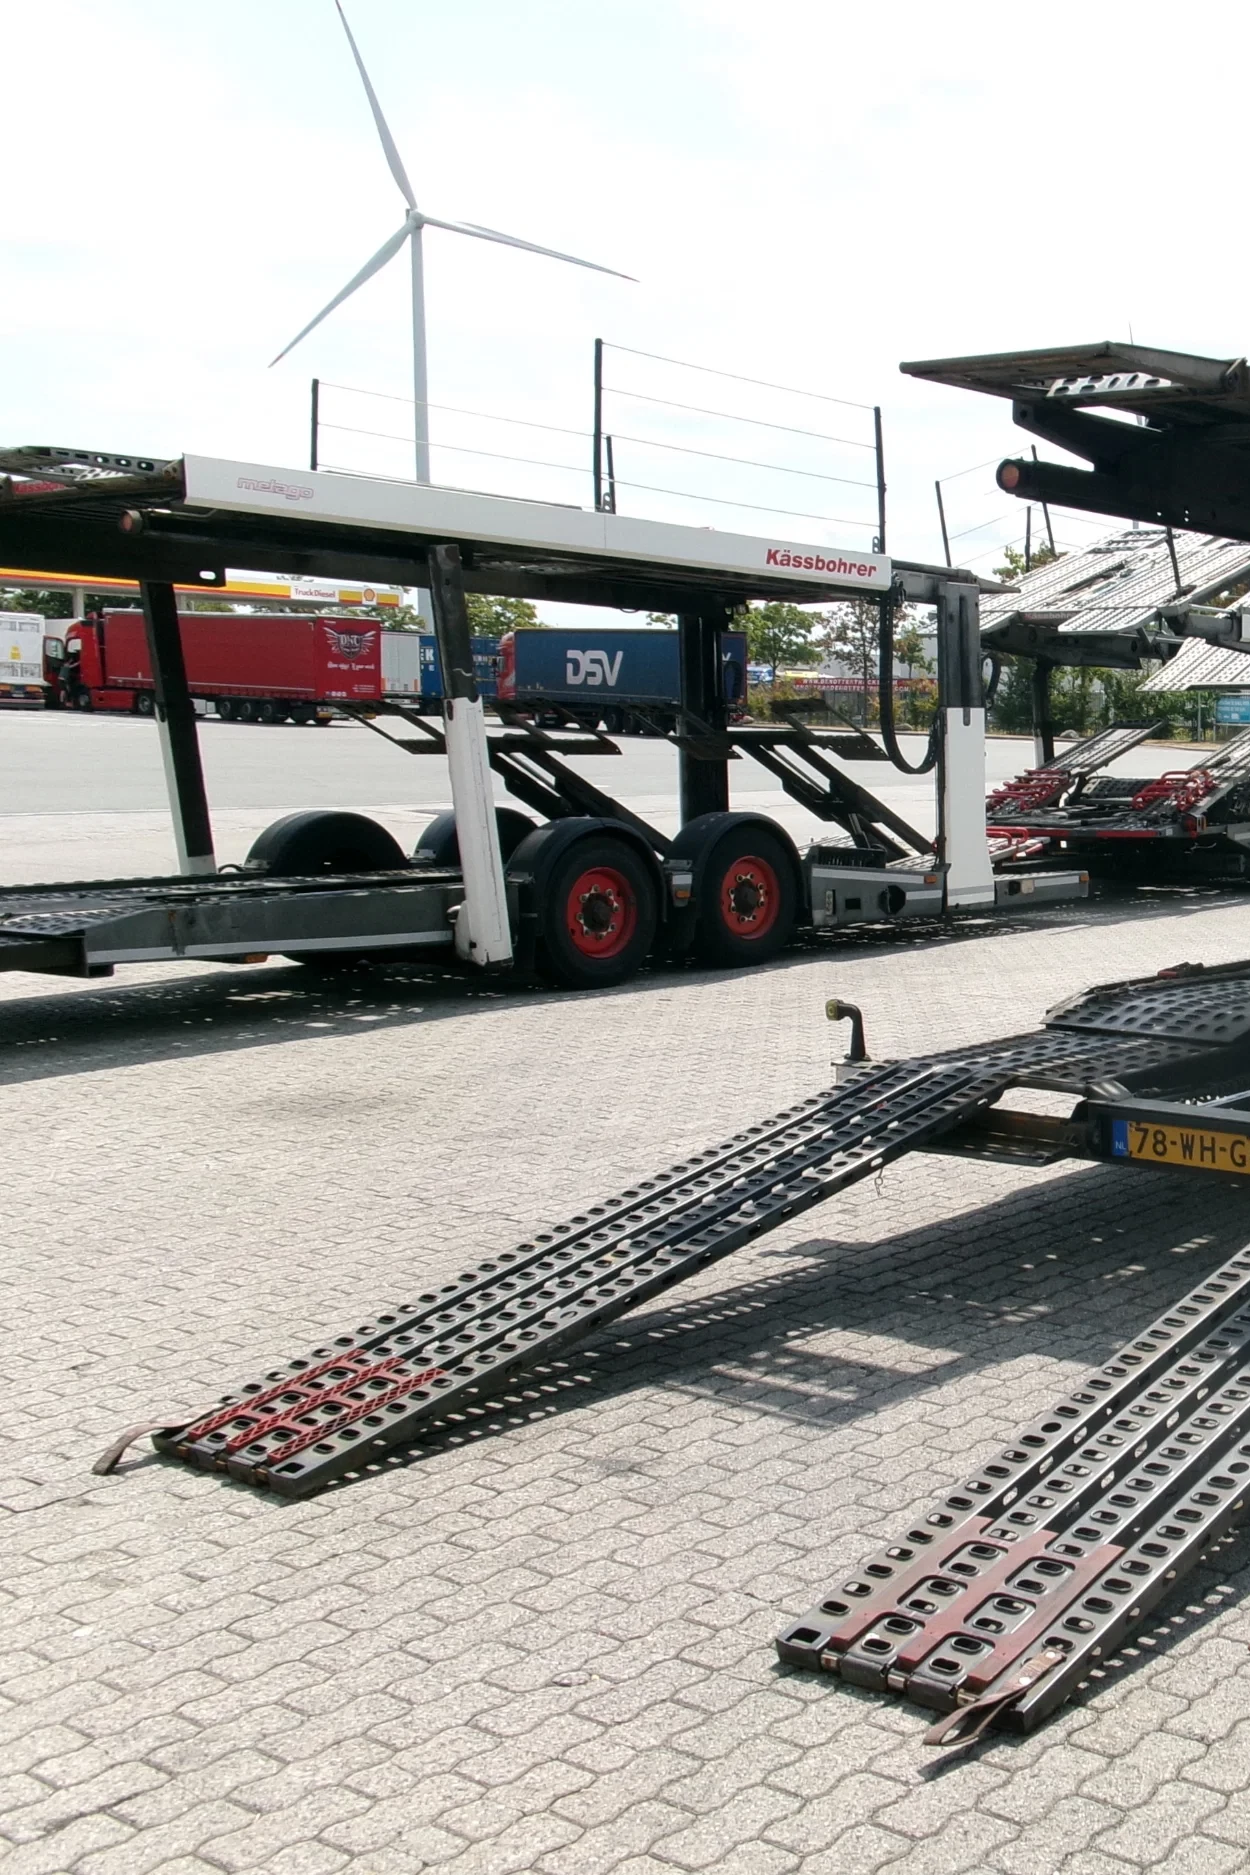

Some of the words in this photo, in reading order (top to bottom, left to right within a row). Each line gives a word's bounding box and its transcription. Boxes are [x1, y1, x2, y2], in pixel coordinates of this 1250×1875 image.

[765, 548, 877, 578] Kässbohrer
[566, 650, 623, 687] DSV
[1115, 1141, 1127, 1150] NL
